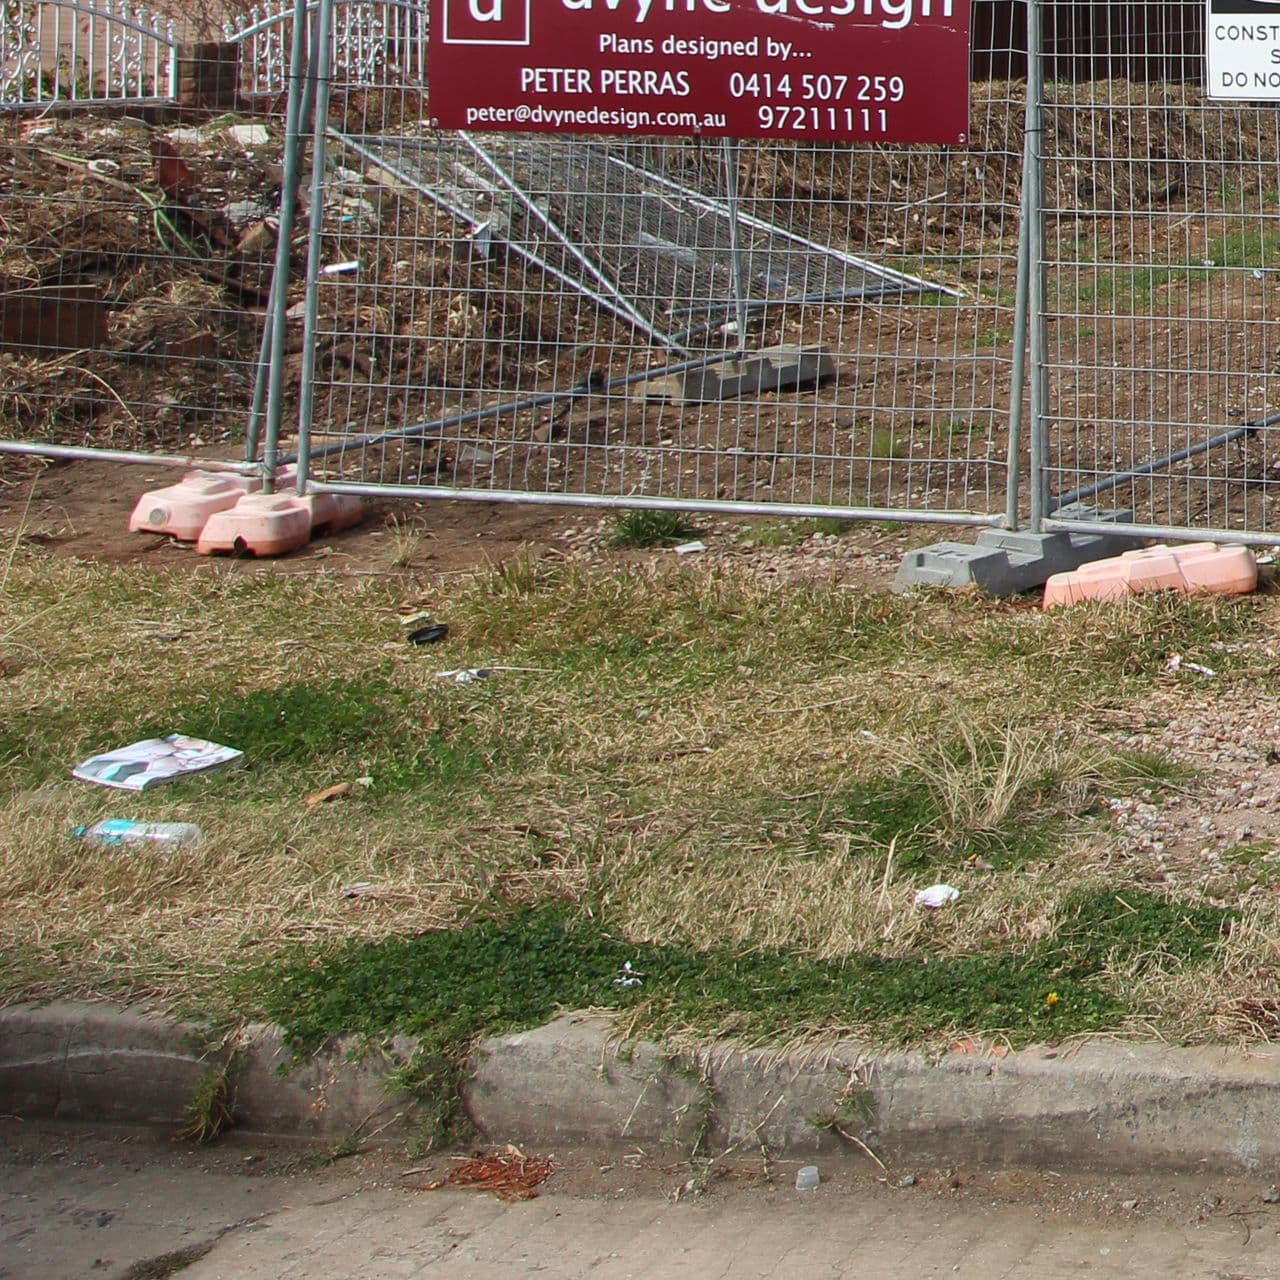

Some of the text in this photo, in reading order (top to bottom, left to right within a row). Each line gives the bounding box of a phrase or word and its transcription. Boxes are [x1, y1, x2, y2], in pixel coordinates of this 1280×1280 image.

[599, 33, 812, 61] Plans designed by...
[521, 67, 904, 102] PETER PERRAS 0414 507 259
[1222, 71, 1248, 88] DO
[466, 104, 888, 132] peter@dvynedesign.com.au 97211111
